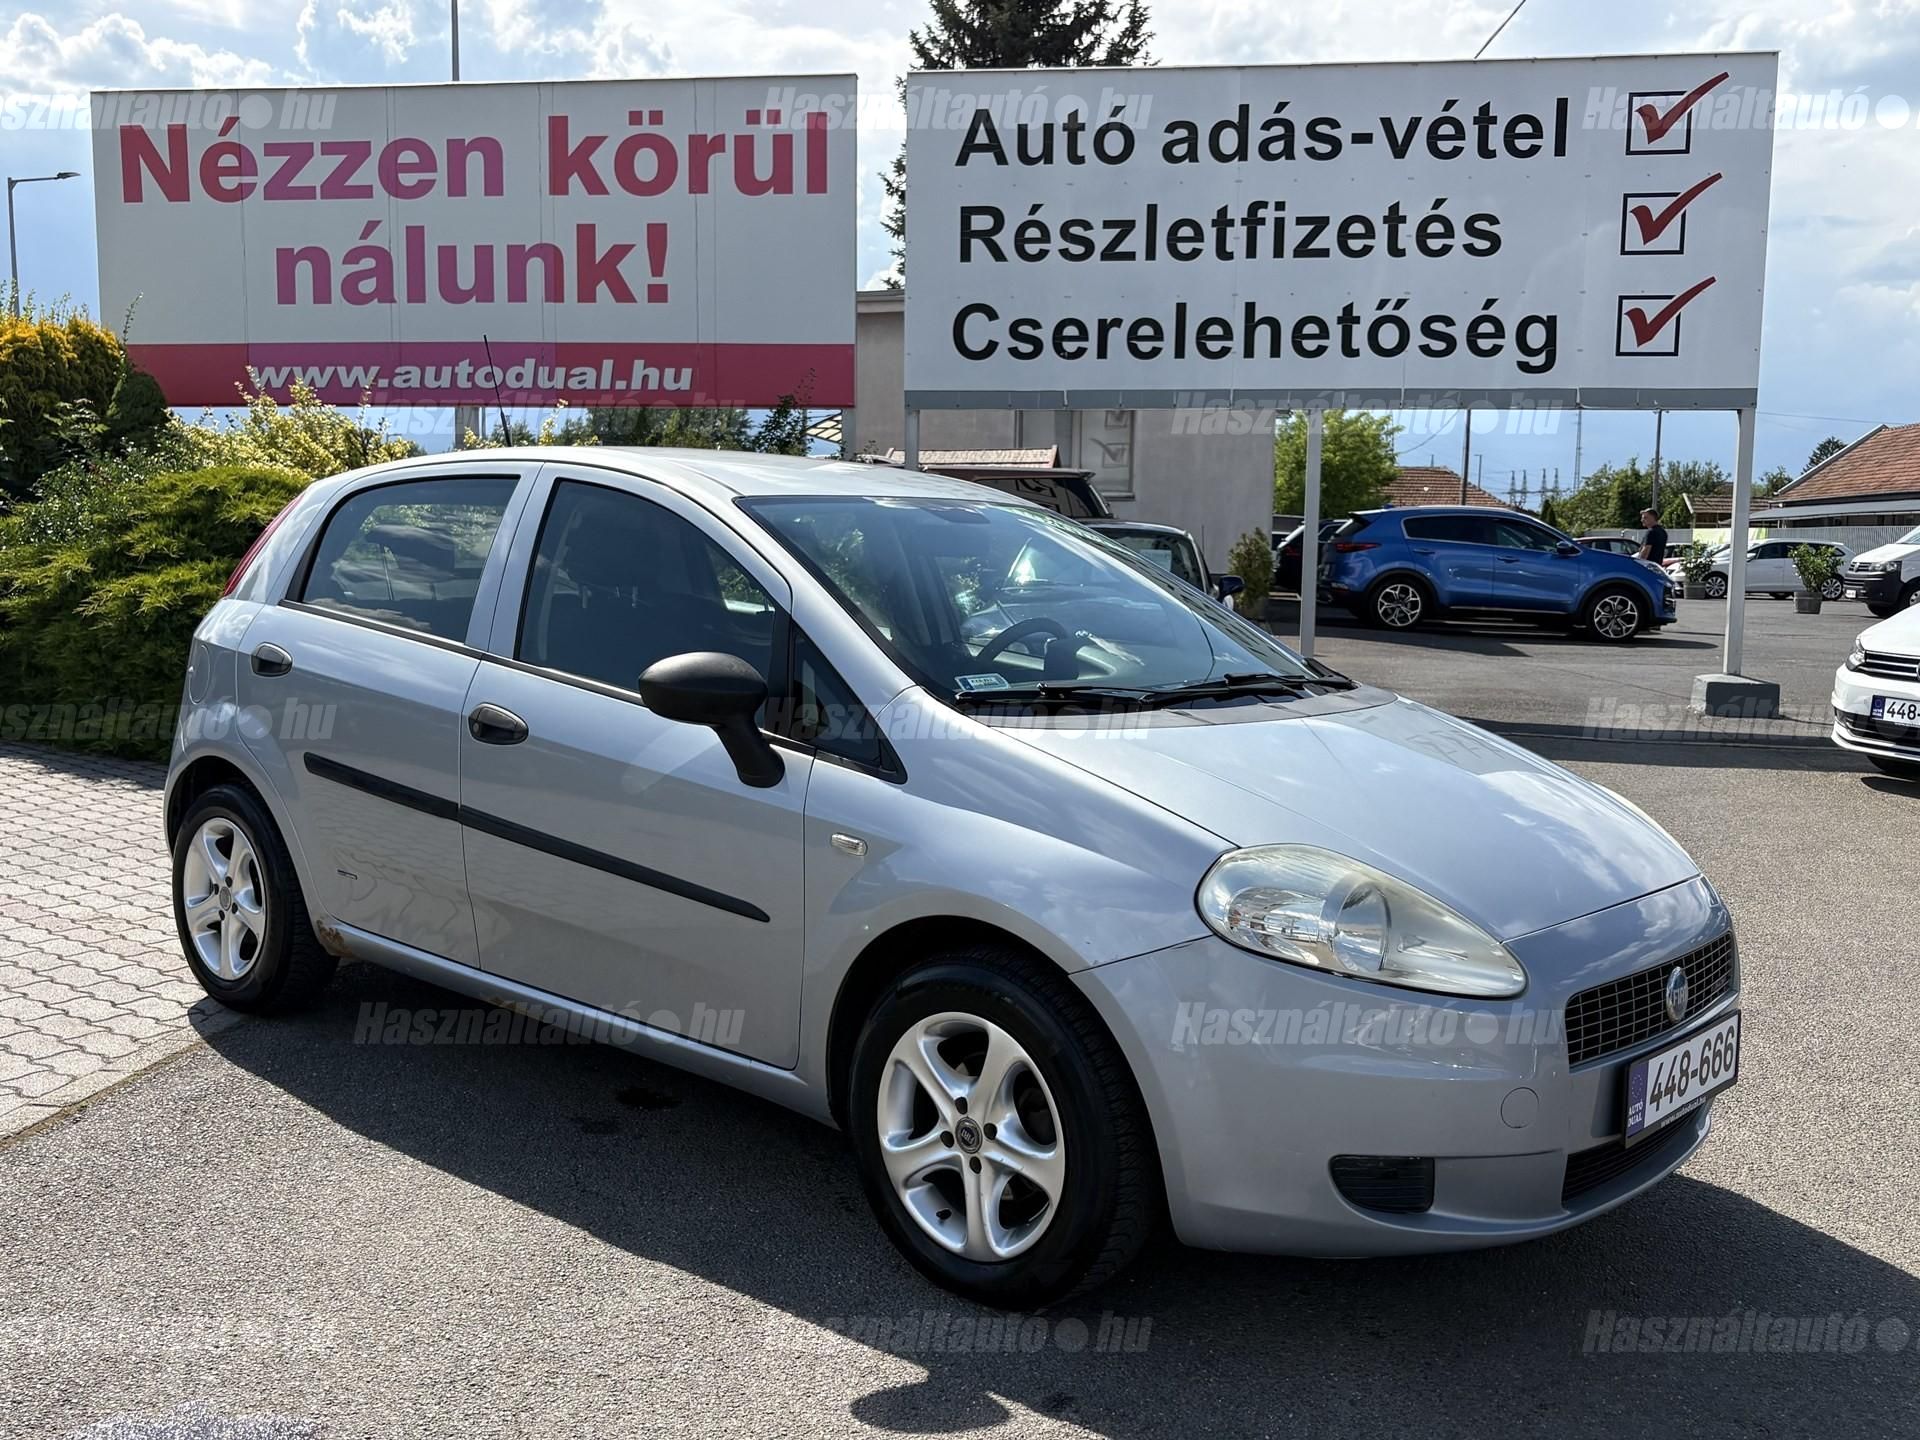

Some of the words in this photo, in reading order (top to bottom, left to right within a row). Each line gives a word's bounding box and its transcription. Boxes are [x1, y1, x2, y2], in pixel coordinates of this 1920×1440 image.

[120, 116, 504, 203] Nézzen
[549, 110, 828, 196] körül
[954, 104, 1135, 167] Autó
[1161, 97, 1569, 165] adás-vétel
[277, 220, 668, 304] nálunk!
[959, 198, 1503, 263] Részletfizetés
[249, 358, 693, 391] www.autodual.hu
[952, 298, 1559, 375] Cserelehetőség
[1649, 1025, 1735, 1113] 448-666
